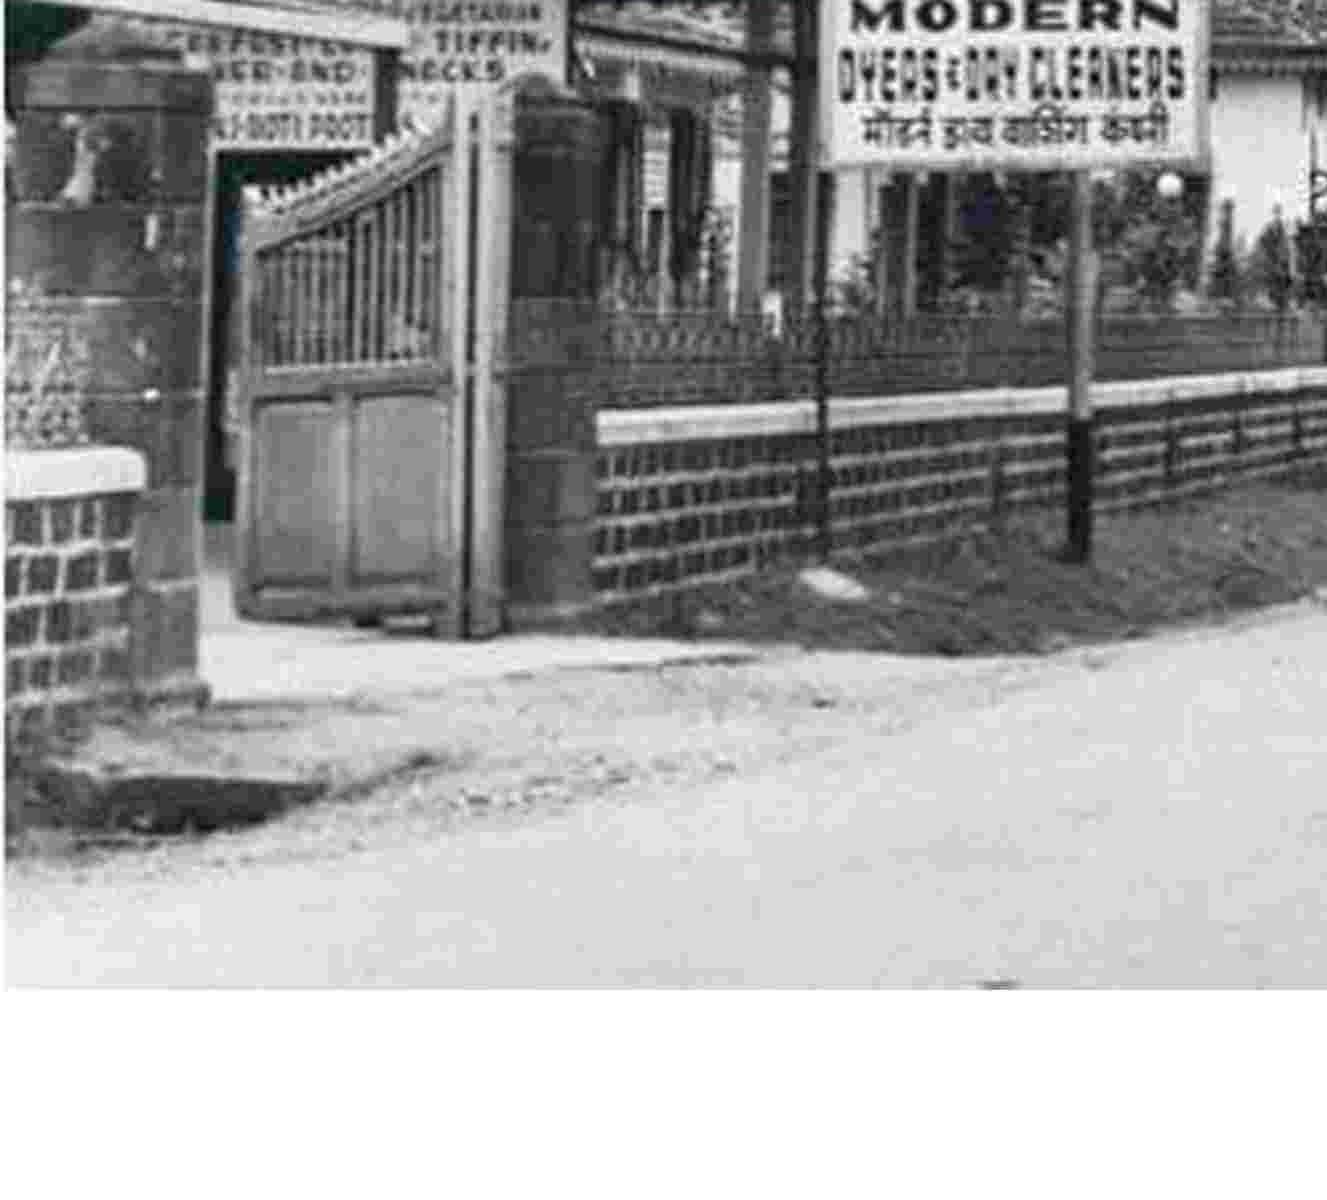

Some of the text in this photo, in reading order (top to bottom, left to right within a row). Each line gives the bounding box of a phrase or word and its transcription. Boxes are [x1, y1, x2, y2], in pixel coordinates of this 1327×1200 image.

[840, 46, 938, 103] DYERS
[966, 46, 1019, 102] DRY
[1031, 45, 1187, 101] CLEANERS
